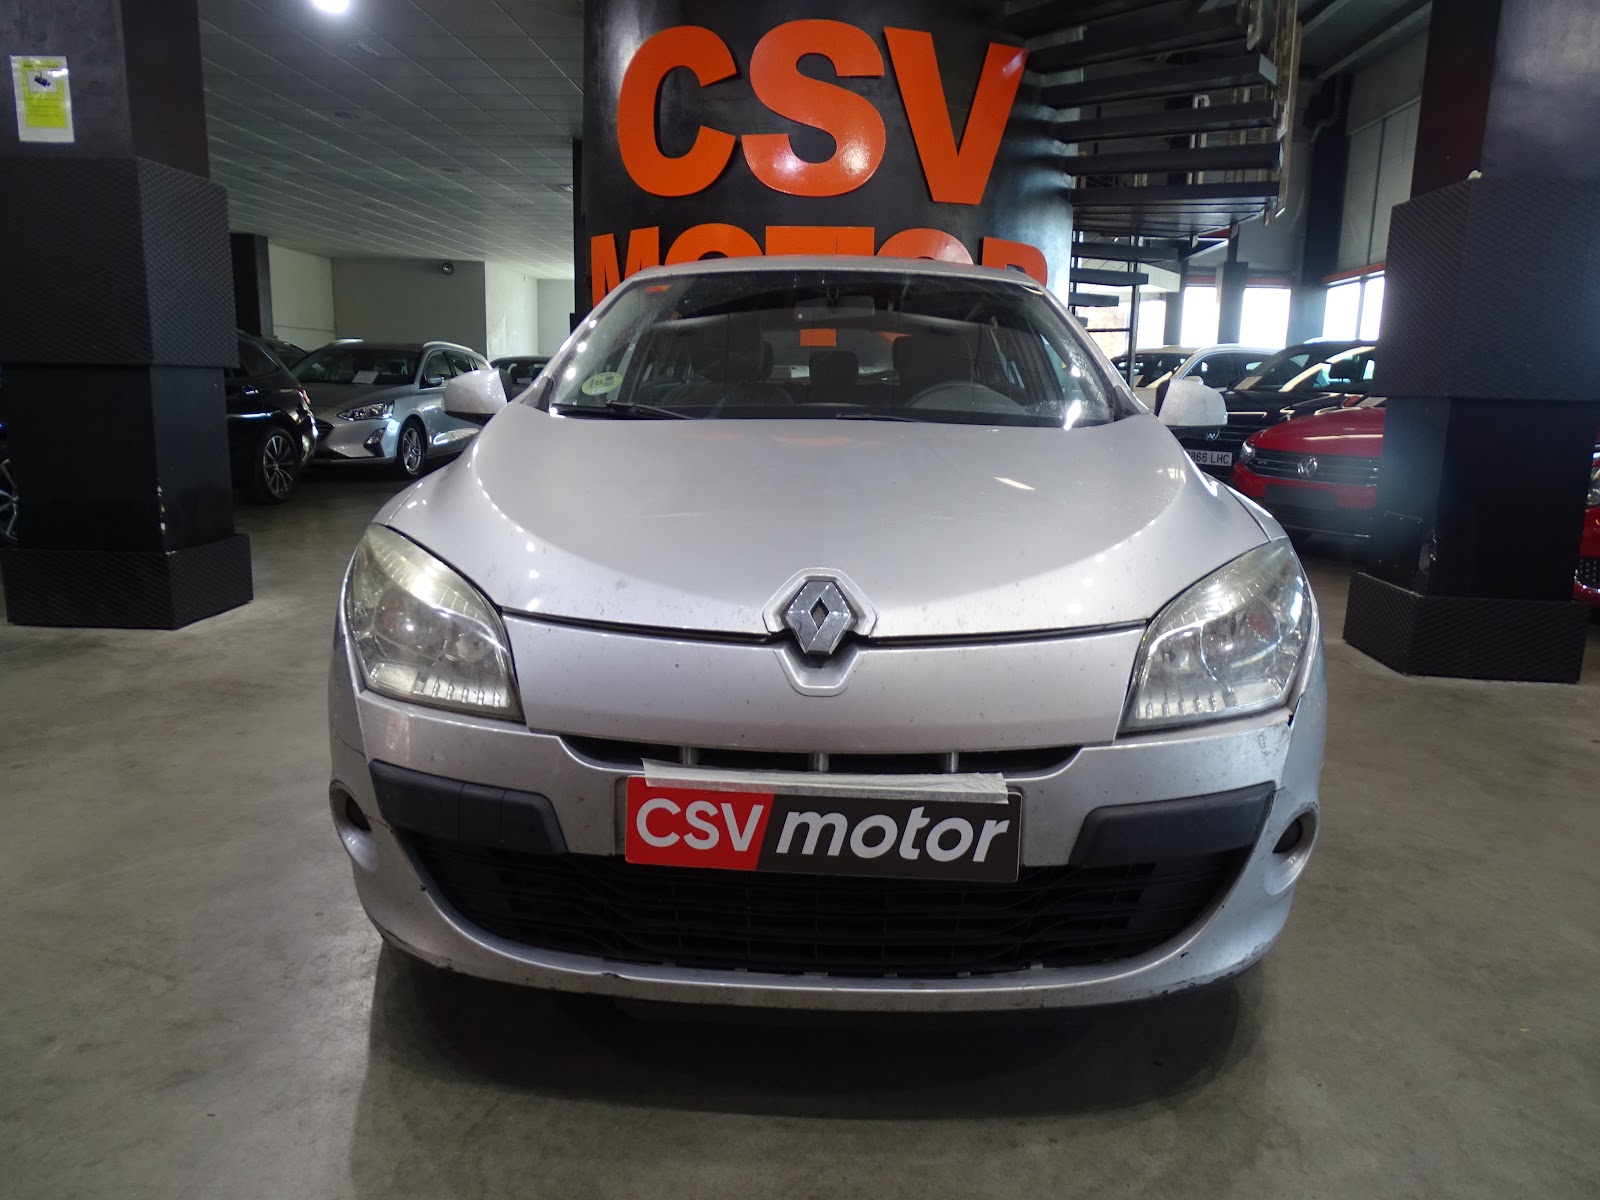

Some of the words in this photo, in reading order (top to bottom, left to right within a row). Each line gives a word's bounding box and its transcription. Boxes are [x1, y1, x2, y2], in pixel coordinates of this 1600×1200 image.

[617, 19, 1029, 205] CSV
[1187, 451, 1208, 463] 866
[1211, 453, 1230, 465] LHC
[636, 798, 764, 851] CSV
[776, 806, 1010, 863] motor
